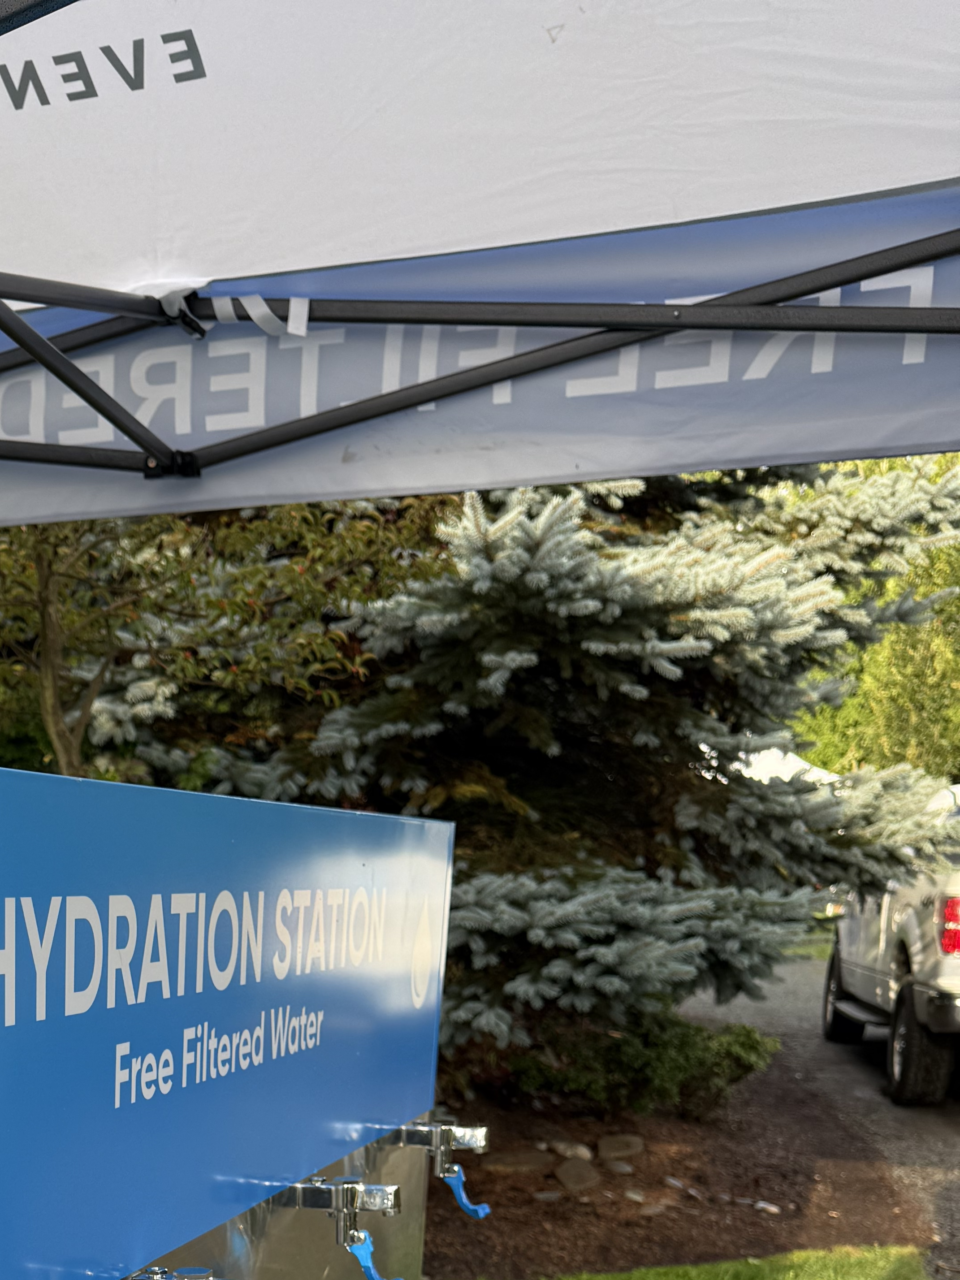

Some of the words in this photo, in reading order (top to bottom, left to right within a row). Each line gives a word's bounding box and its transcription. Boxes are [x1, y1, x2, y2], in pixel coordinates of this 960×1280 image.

[272, 886, 387, 980] STATION
[114, 1041, 175, 1109] Free
[181, 1021, 265, 1088] Filtered
[270, 1005, 325, 1060] Water
